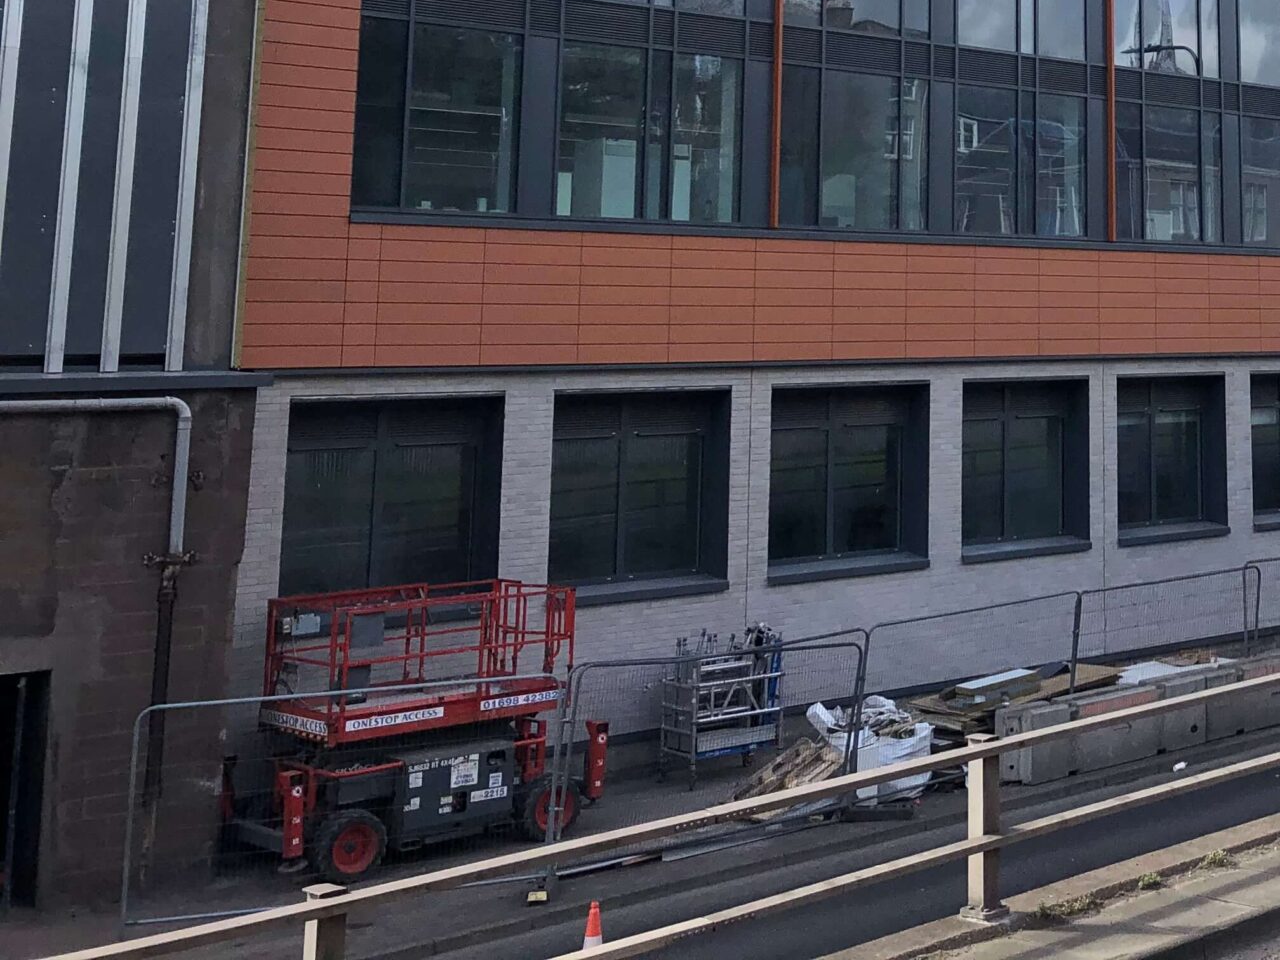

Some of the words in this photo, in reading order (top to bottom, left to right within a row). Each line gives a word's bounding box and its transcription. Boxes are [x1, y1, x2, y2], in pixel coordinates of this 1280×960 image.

[483, 697, 520, 710] 01698
[523, 690, 565, 703] 42382
[267, 711, 299, 728] ONESTOP
[299, 718, 327, 734] ACCESS
[352, 714, 400, 729] ONESTOP
[401, 709, 438, 722] ACCESS
[484, 787, 505, 799] 2215
